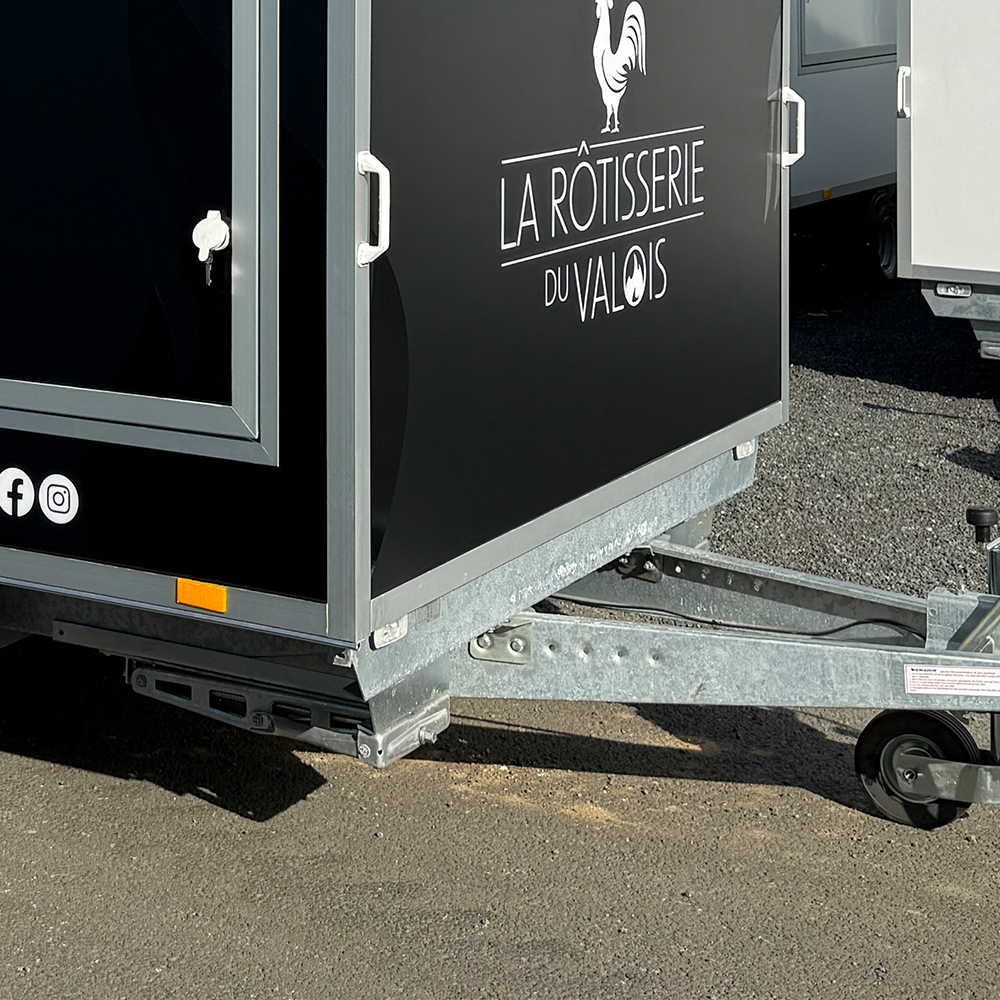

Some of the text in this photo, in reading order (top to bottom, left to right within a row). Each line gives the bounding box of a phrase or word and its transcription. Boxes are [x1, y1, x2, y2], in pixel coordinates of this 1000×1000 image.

[500, 139, 705, 251] LA RÔTISSERIE
[544, 237, 668, 323] DU VALOIS
